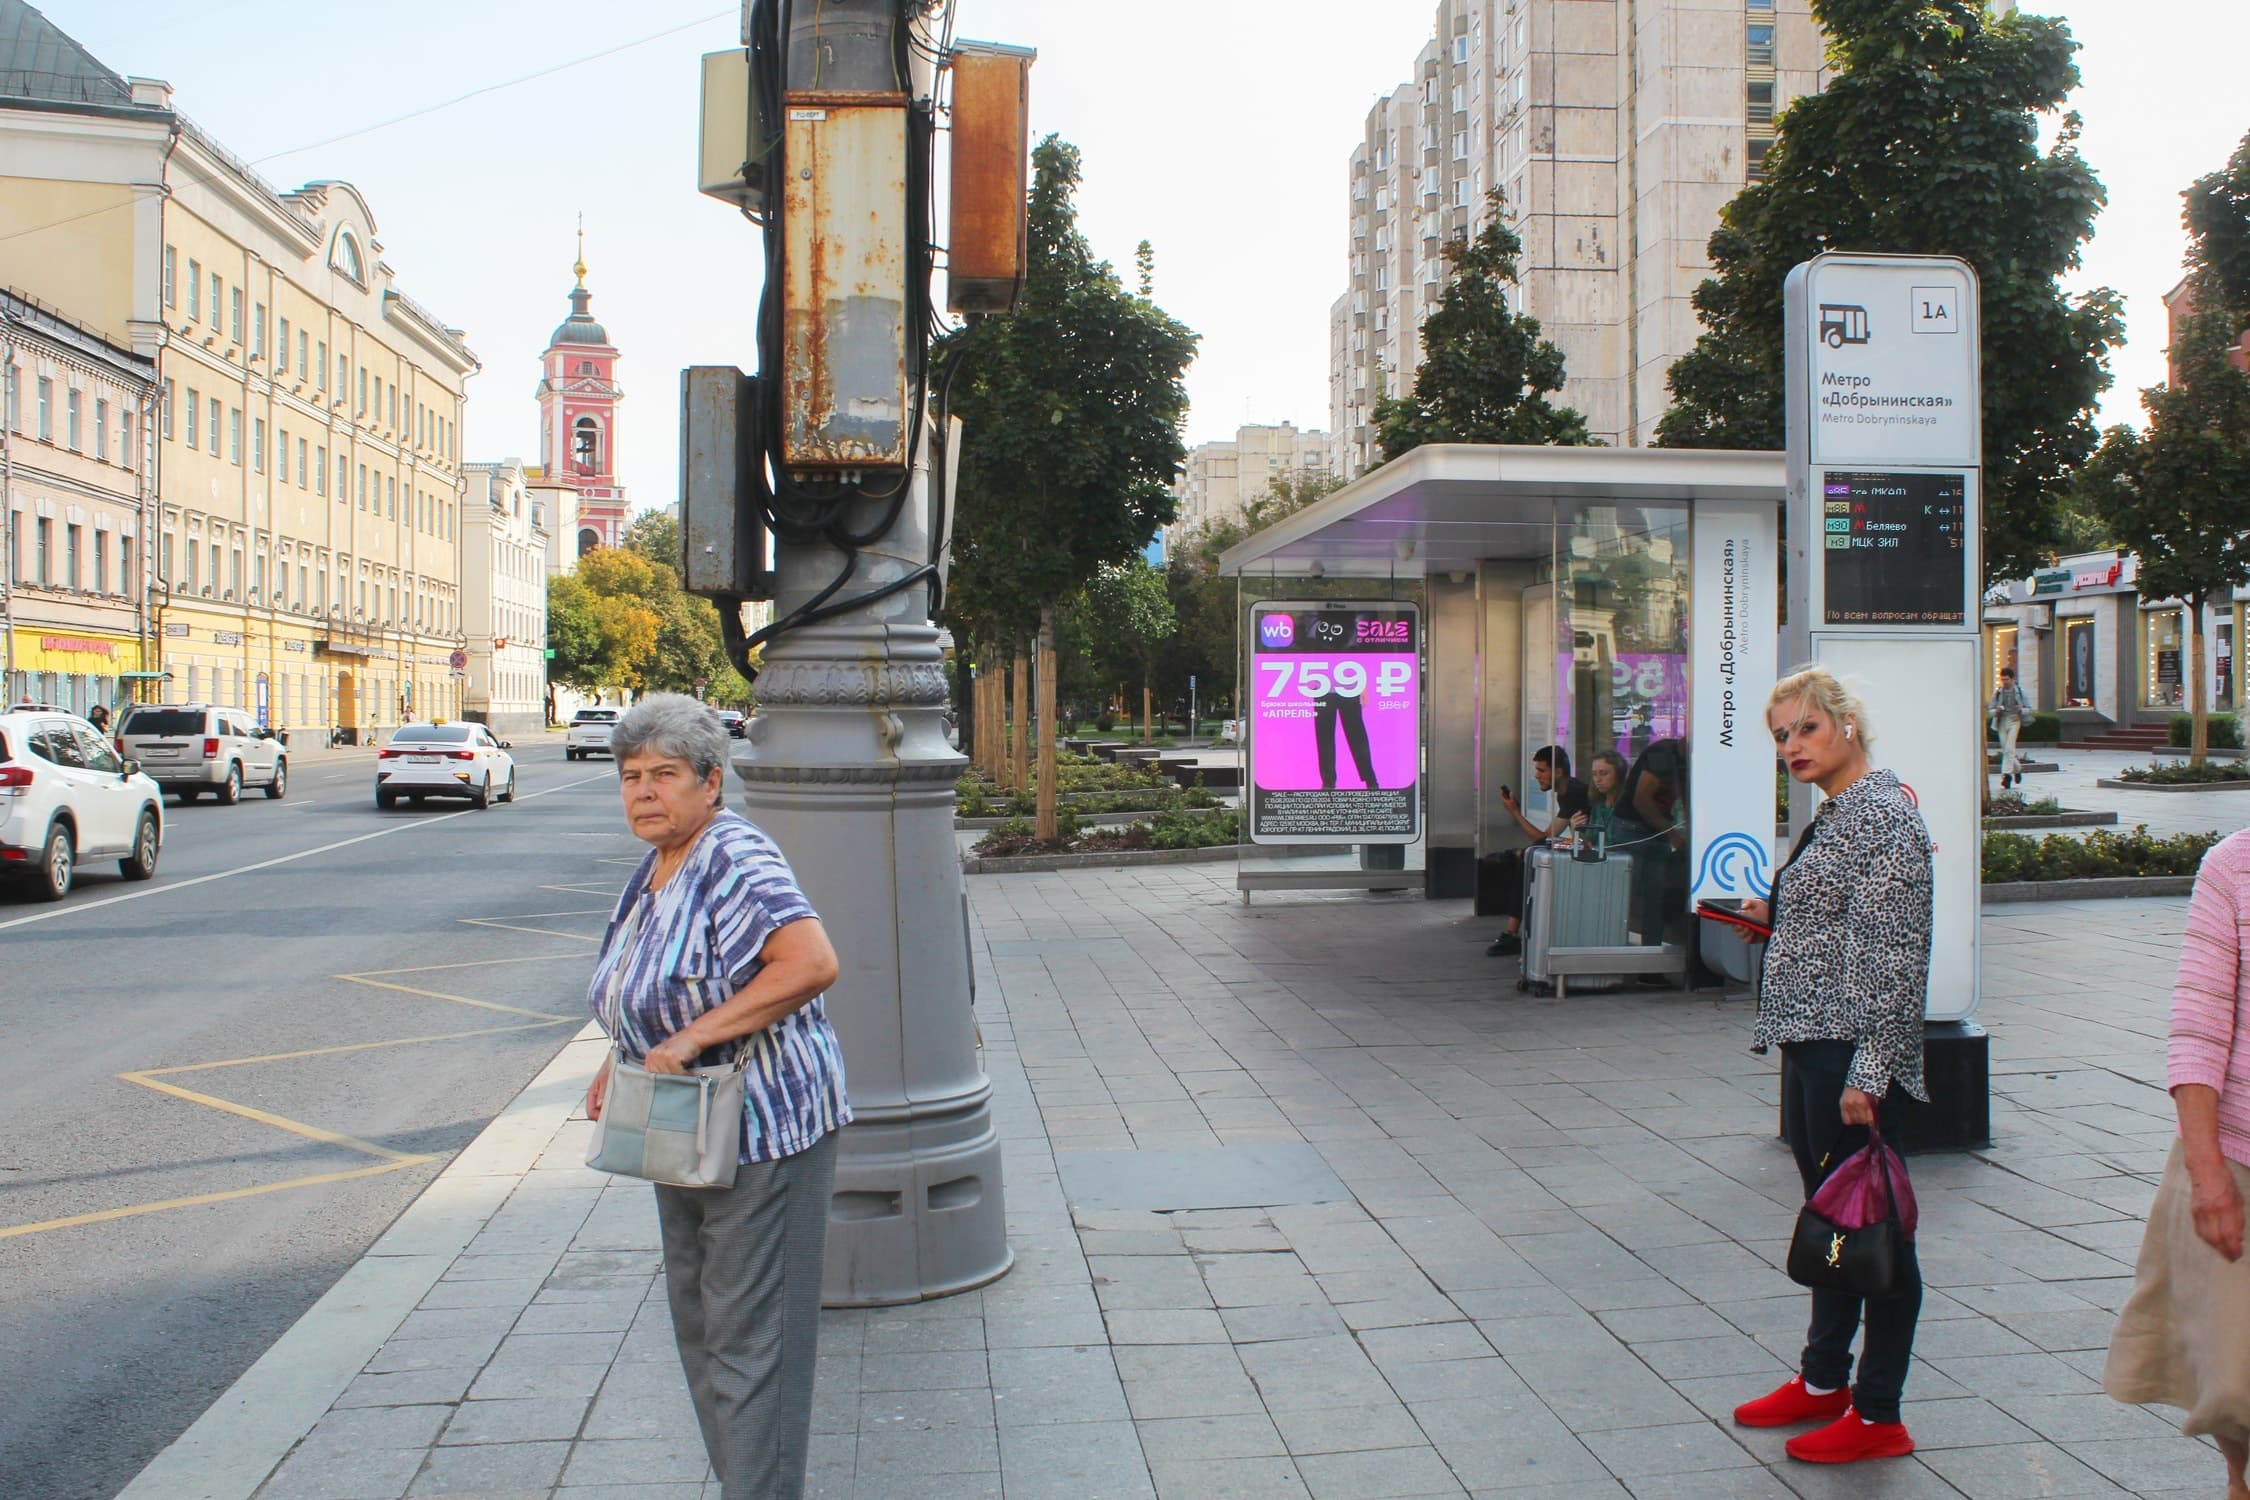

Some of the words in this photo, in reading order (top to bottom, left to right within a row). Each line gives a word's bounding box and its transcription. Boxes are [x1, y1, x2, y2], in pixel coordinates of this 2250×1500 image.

[1822, 372, 1871, 389] Метро
[1822, 392, 1953, 409] «Добрынинская»
[1822, 413, 1854, 424] Metro
[1857, 413, 1937, 427] Dobryninskaya
[1866, 520, 1907, 531] Беляево
[1852, 537, 1874, 549] МЦК
[1877, 537, 1899, 549] ЗИЛ
[1739, 538, 1752, 618] Dobryninskaya
[1719, 538, 1736, 685] «Добрынинская»
[1844, 612, 1869, 620] всем
[1872, 612, 1919, 620] вопросам
[1739, 621, 1749, 655] Metro
[1261, 661, 1367, 698] 759
[1262, 709, 1318, 719] «АПРЕЛЬ»
[1719, 689, 1736, 748] Метро
